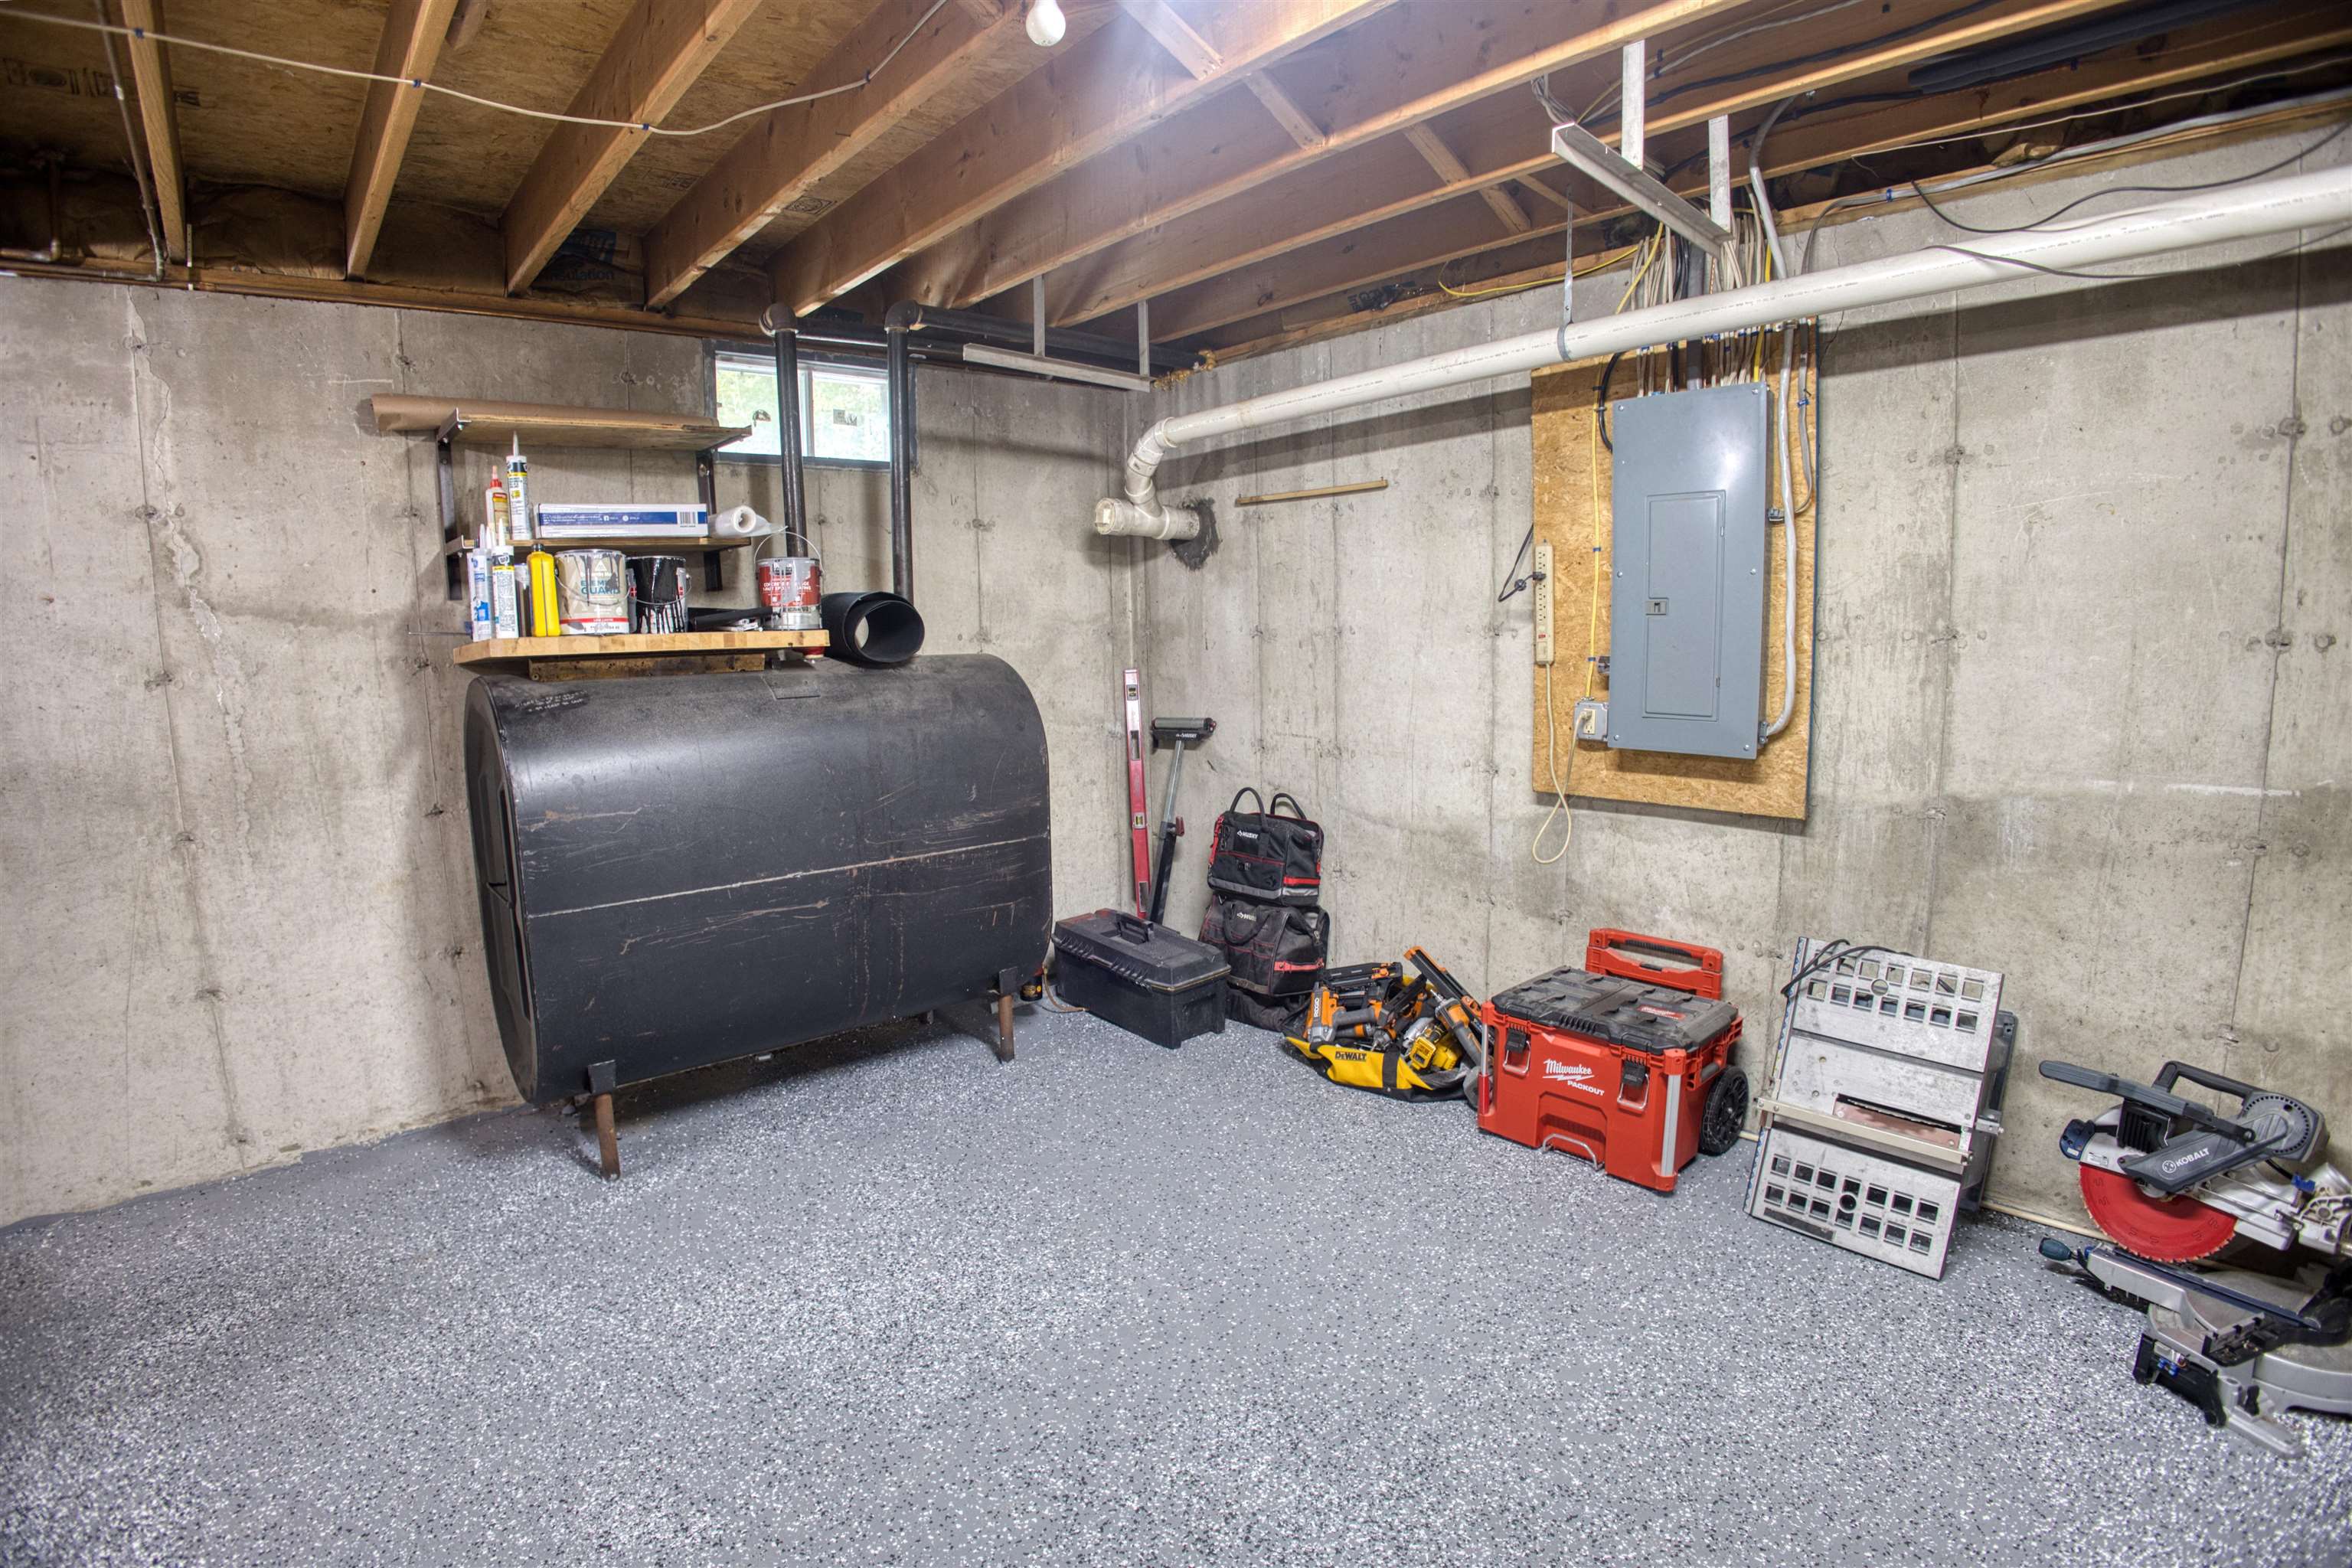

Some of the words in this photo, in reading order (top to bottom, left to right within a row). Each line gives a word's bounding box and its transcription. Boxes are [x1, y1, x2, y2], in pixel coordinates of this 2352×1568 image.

[1544, 1058, 1592, 1074] Milwaukee
[1567, 1080, 1605, 1096] PACKOUT
[2175, 1147, 2210, 1167] KOBALT
